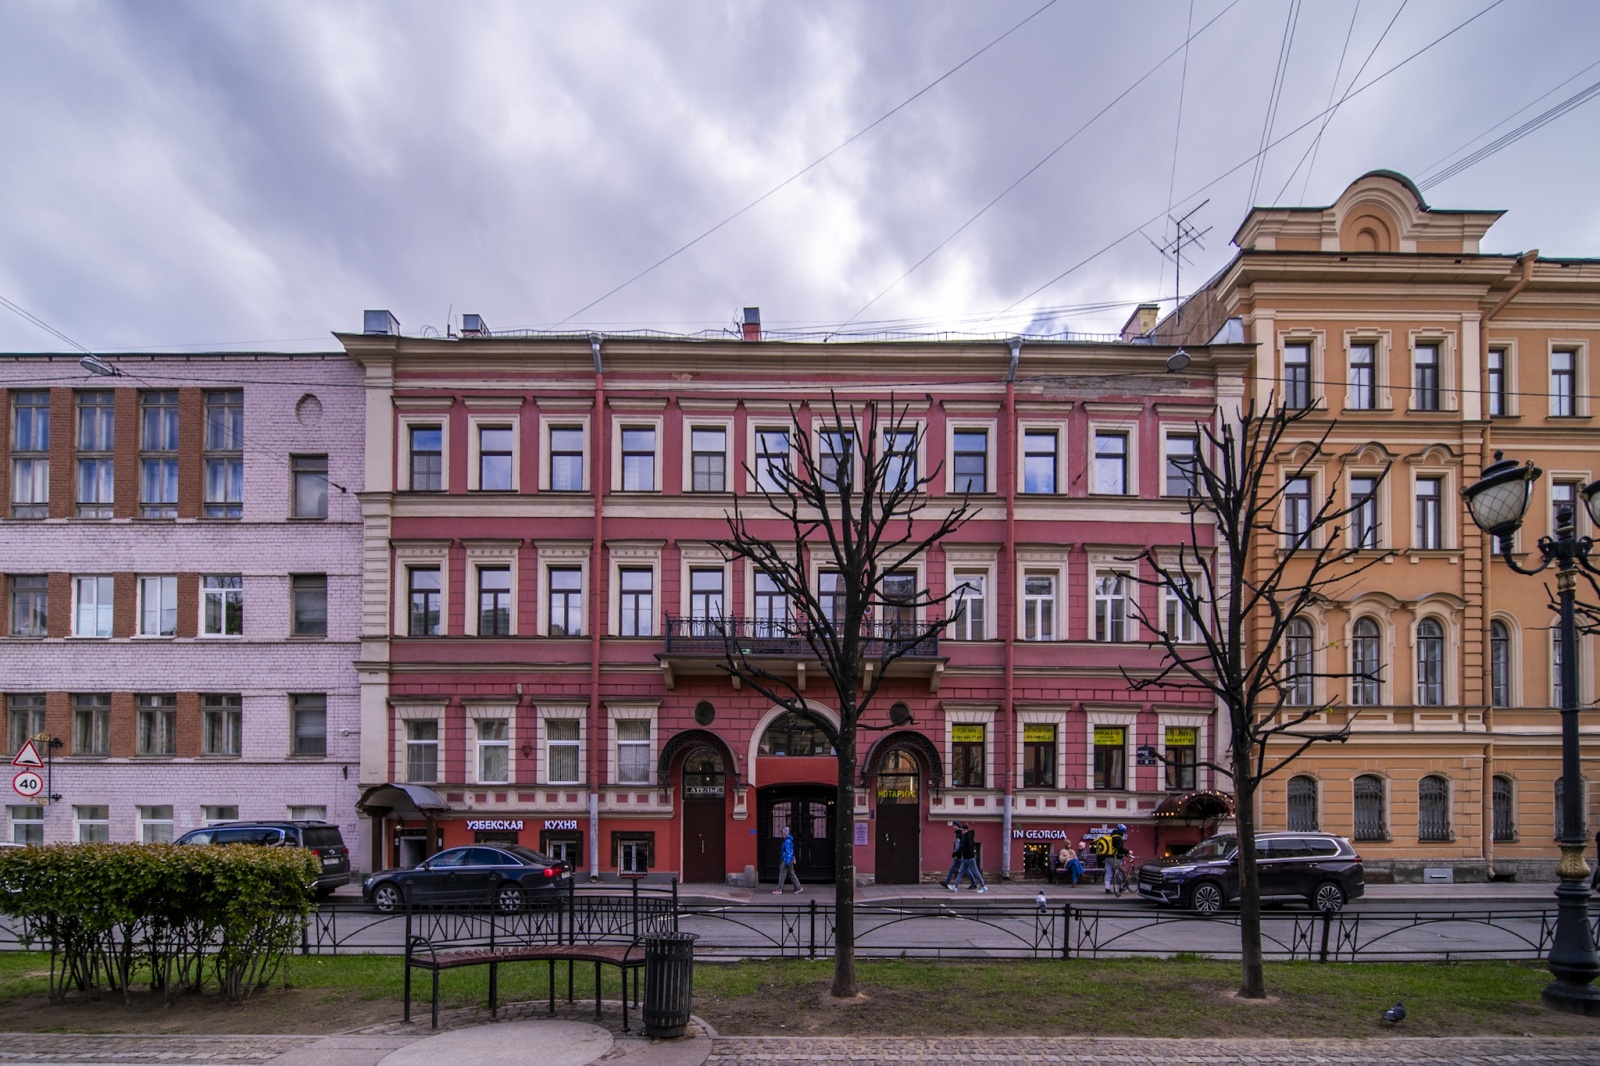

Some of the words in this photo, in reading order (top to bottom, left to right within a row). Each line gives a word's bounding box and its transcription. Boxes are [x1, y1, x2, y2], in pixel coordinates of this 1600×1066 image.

[19, 779, 37, 789] 40
[877, 790, 917, 798] НОТАРИУС
[466, 820, 524, 830] УЗБЕКСКАЯ
[544, 820, 577, 830] КУХНЯ
[1013, 829, 1024, 839] IN
[1026, 829, 1067, 839] GEORGIA
